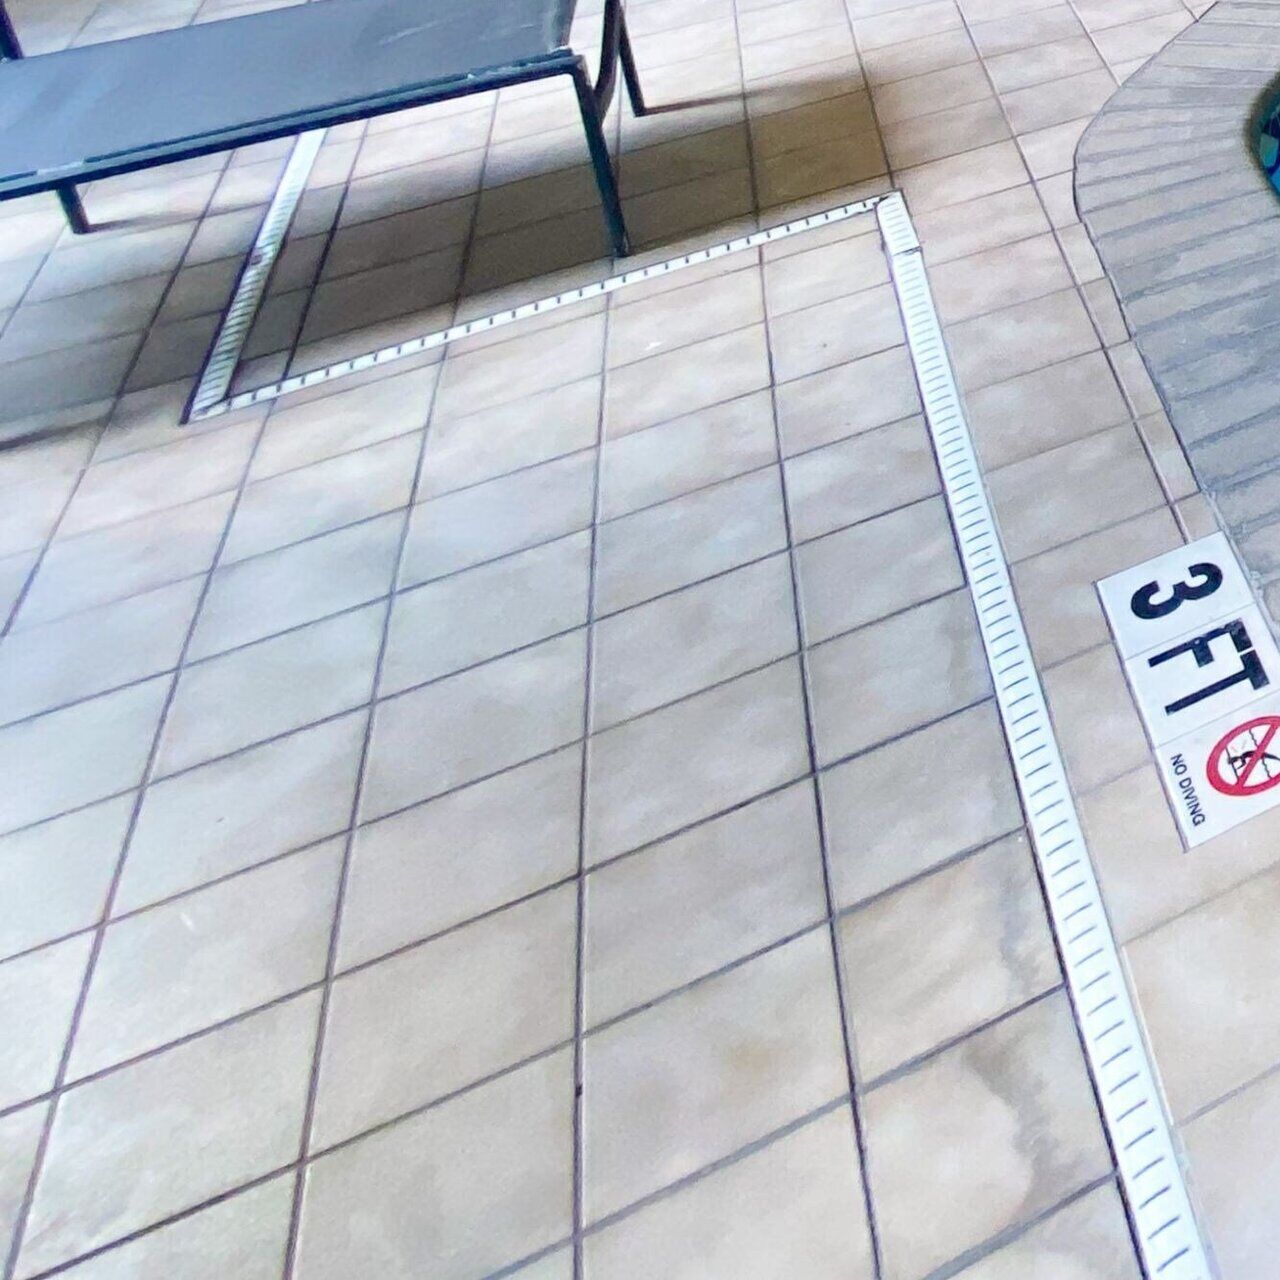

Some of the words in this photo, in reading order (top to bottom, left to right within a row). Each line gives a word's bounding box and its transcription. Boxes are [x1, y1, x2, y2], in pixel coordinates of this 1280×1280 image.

[1130, 562, 1223, 620] 3
[1147, 618, 1270, 717] FT
[1170, 752, 1188, 776] NO
[1178, 776, 1206, 827] DIVING
